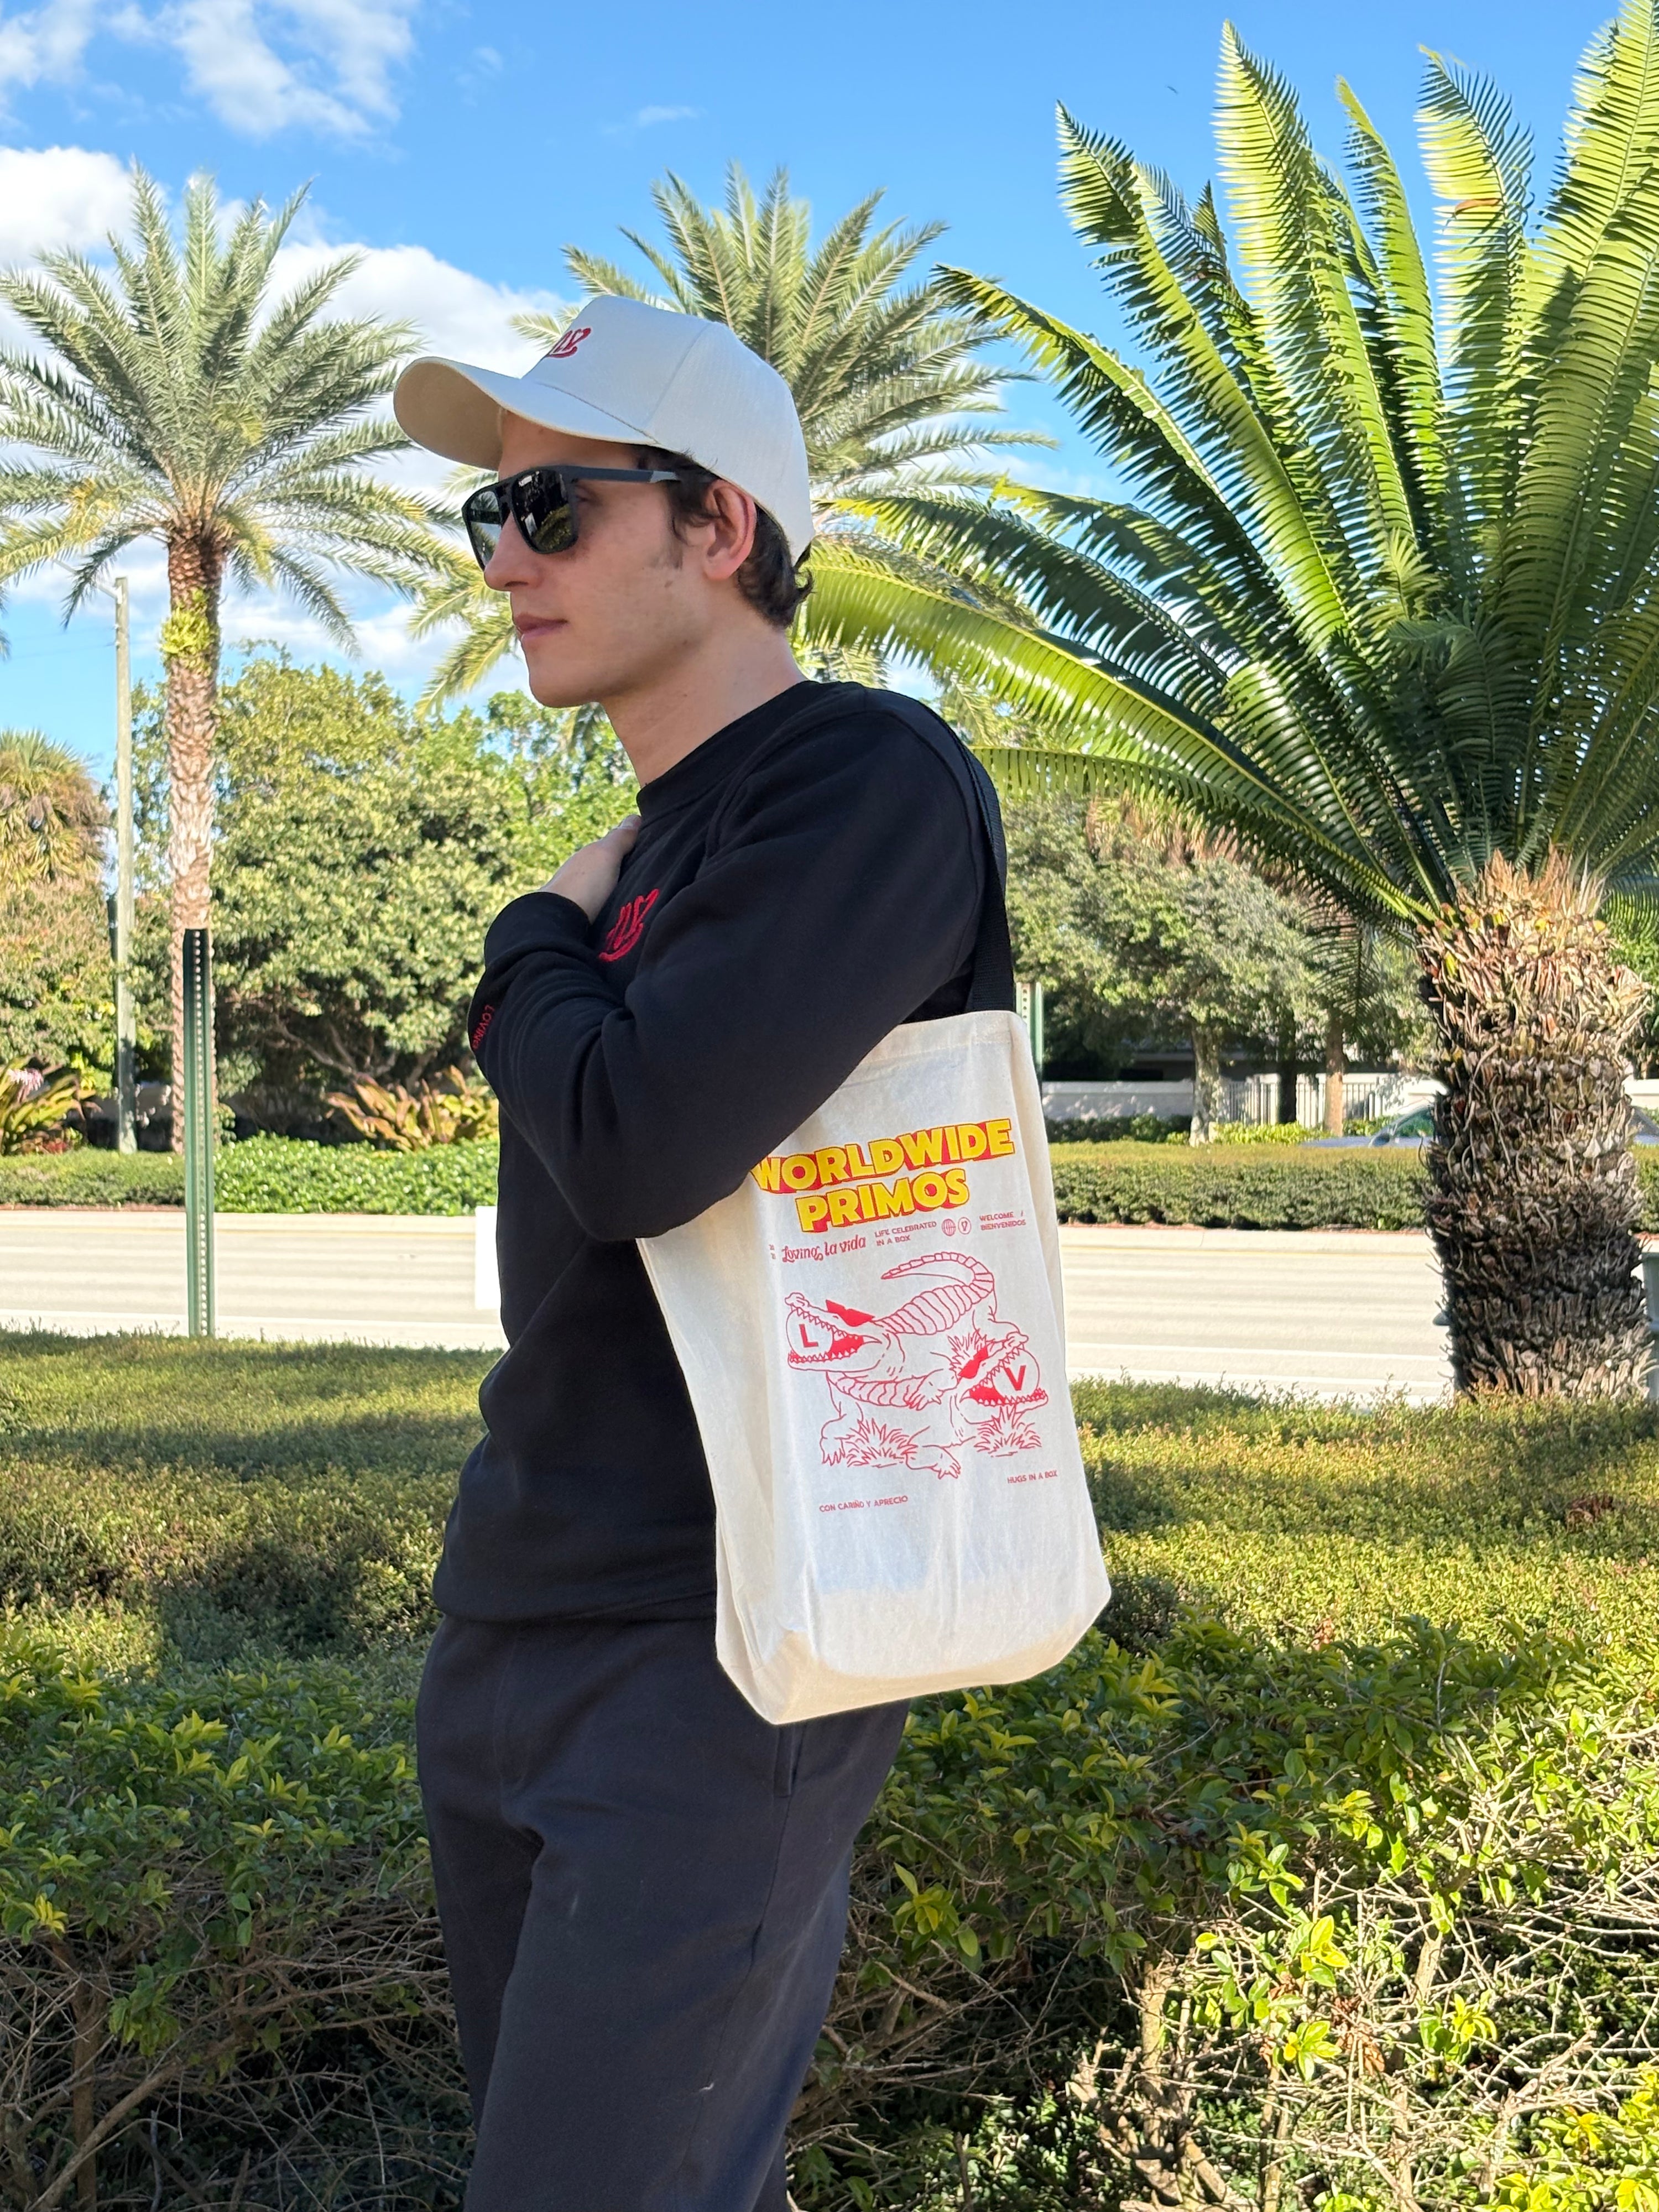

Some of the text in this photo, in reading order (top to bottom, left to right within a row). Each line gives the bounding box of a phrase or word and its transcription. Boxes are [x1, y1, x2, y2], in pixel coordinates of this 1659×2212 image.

[749, 1118, 1015, 1194] WORLDWIDE
[795, 1168, 970, 1233] PRIMOS
[979, 1211, 1014, 1222] WELCOME
[980, 1219, 1026, 1230] BIENVENIDOS
[874, 1221, 937, 1238] LIFE CELEBRATED
[894, 1235, 911, 1243] BOX
[781, 1245, 823, 1263] Loving
[824, 1241, 837, 1256] la
[839, 1234, 866, 1253] vida
[799, 1323, 818, 1348] L
[1005, 1365, 1026, 1392] V
[1007, 1474, 1027, 1484] HUGS
[1045, 1469, 1057, 1478] BOX
[819, 1504, 836, 1512] CON
[837, 1500, 864, 1510] CARIÑO
[874, 1495, 909, 1507] APRECIO
